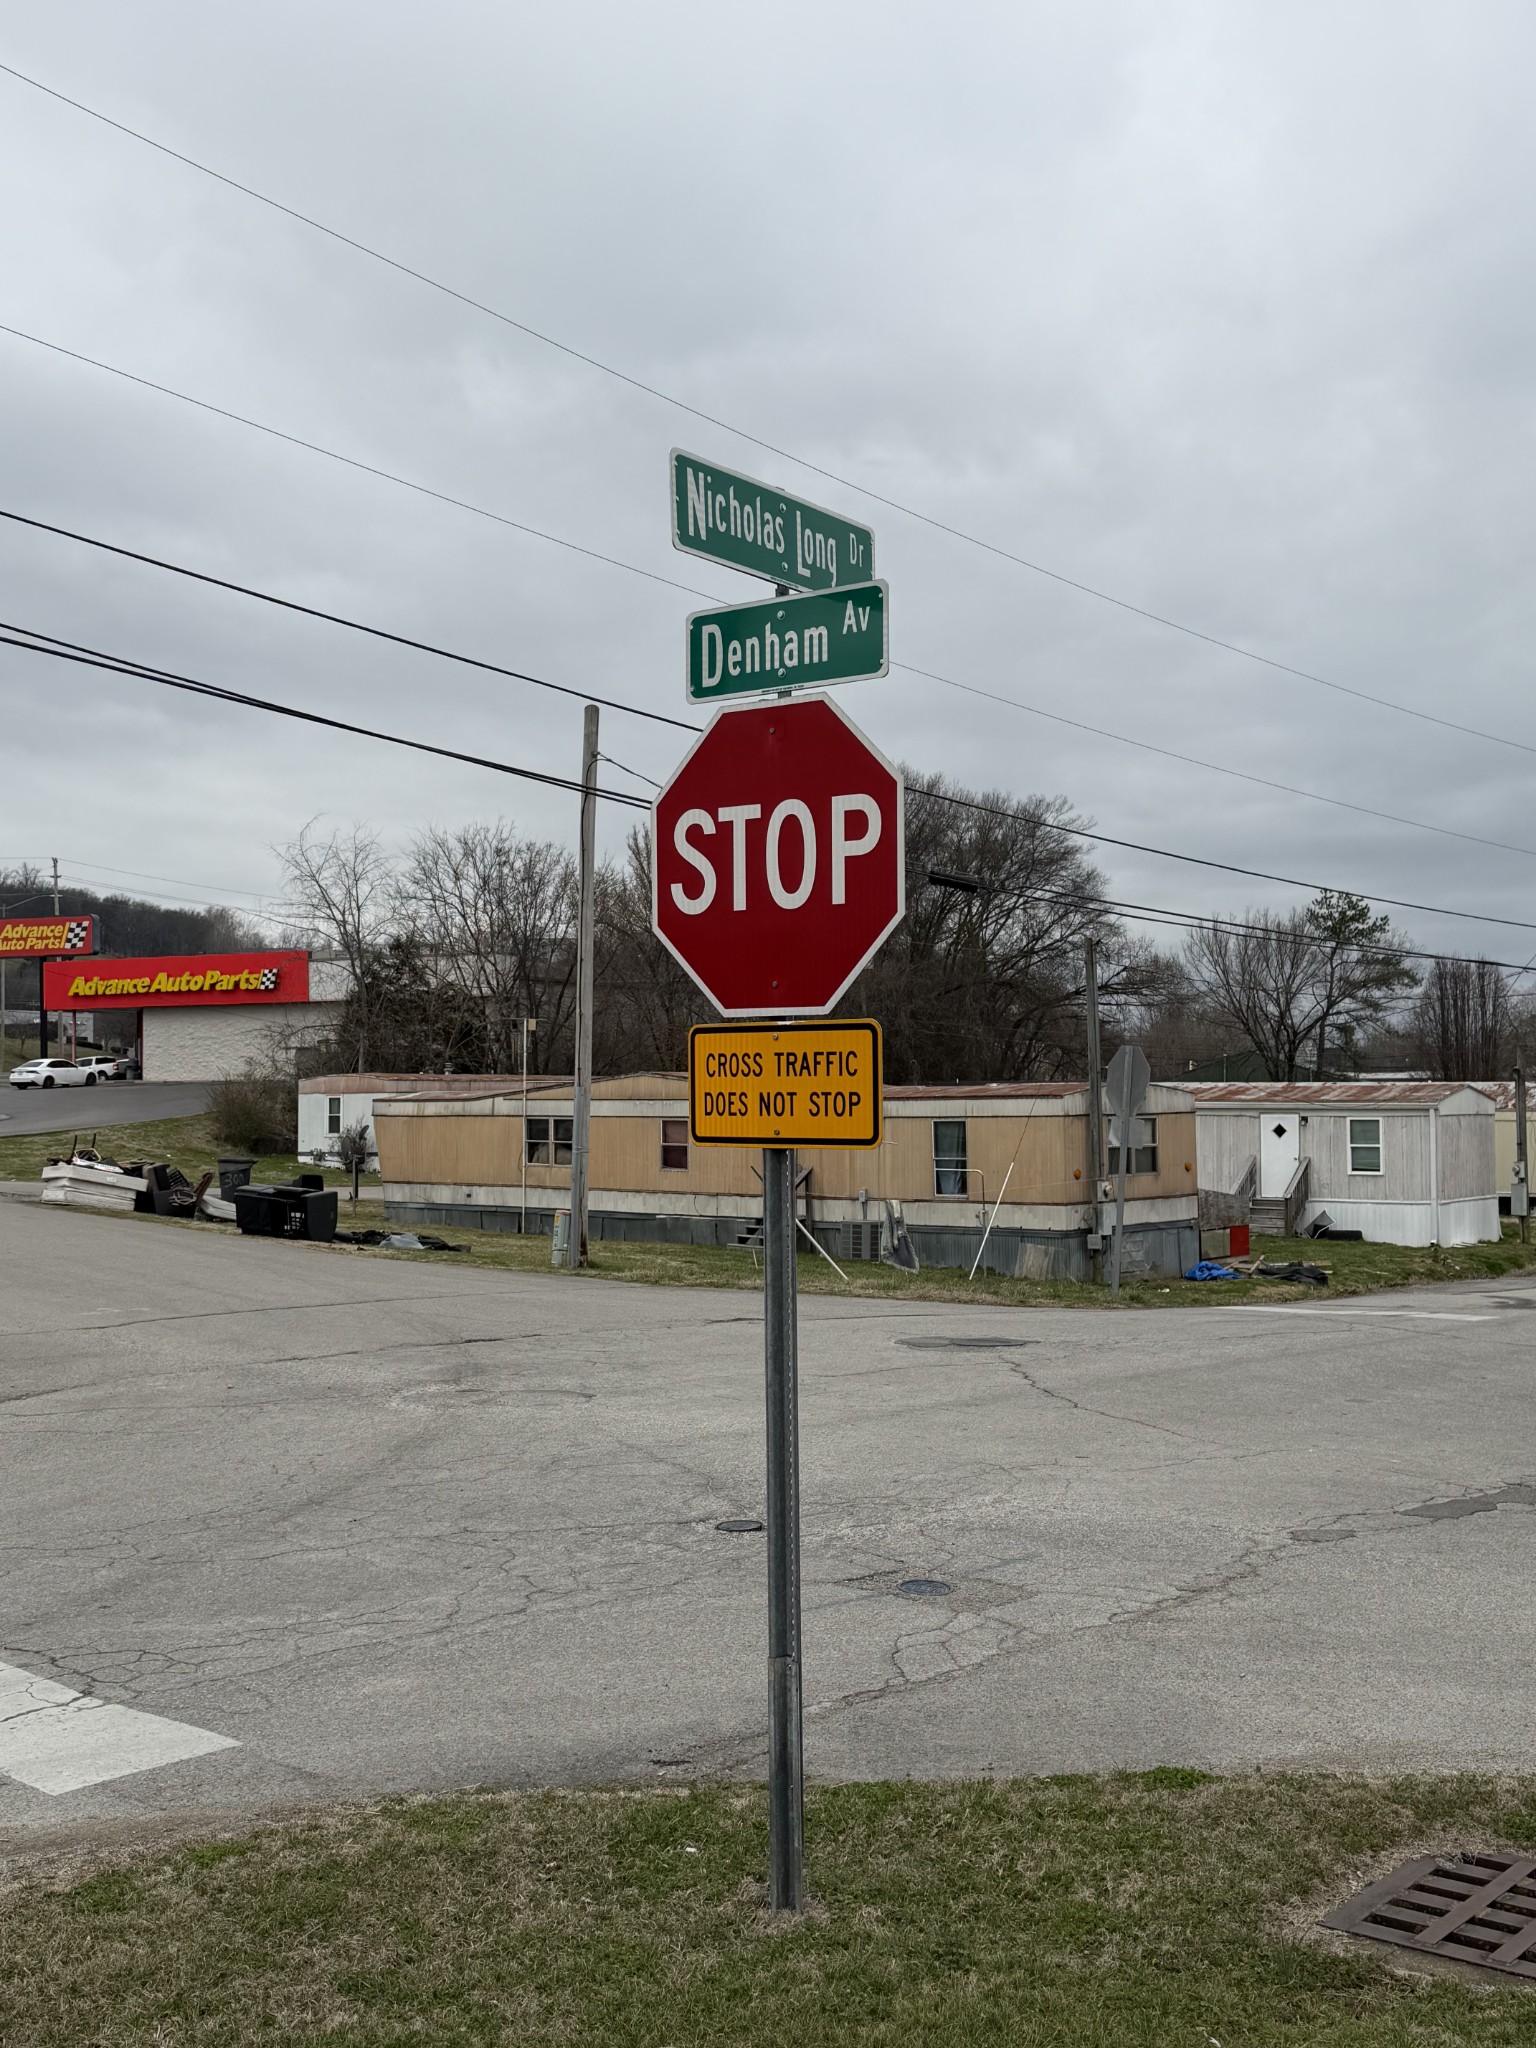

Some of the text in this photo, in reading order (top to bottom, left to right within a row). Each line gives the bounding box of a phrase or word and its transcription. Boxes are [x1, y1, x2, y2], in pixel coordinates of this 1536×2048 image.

[686, 466, 864, 588] Nicholas Long Dr
[701, 600, 871, 688] Denham Av
[670, 793, 882, 916] STOP
[0, 923, 63, 938] Advance
[0, 936, 60, 951] uto Parts
[67, 969, 260, 996] Advance Auto Parts
[706, 1050, 858, 1078] CROSS TRAFFIC
[704, 1091, 861, 1117] DOES NOT STOP
